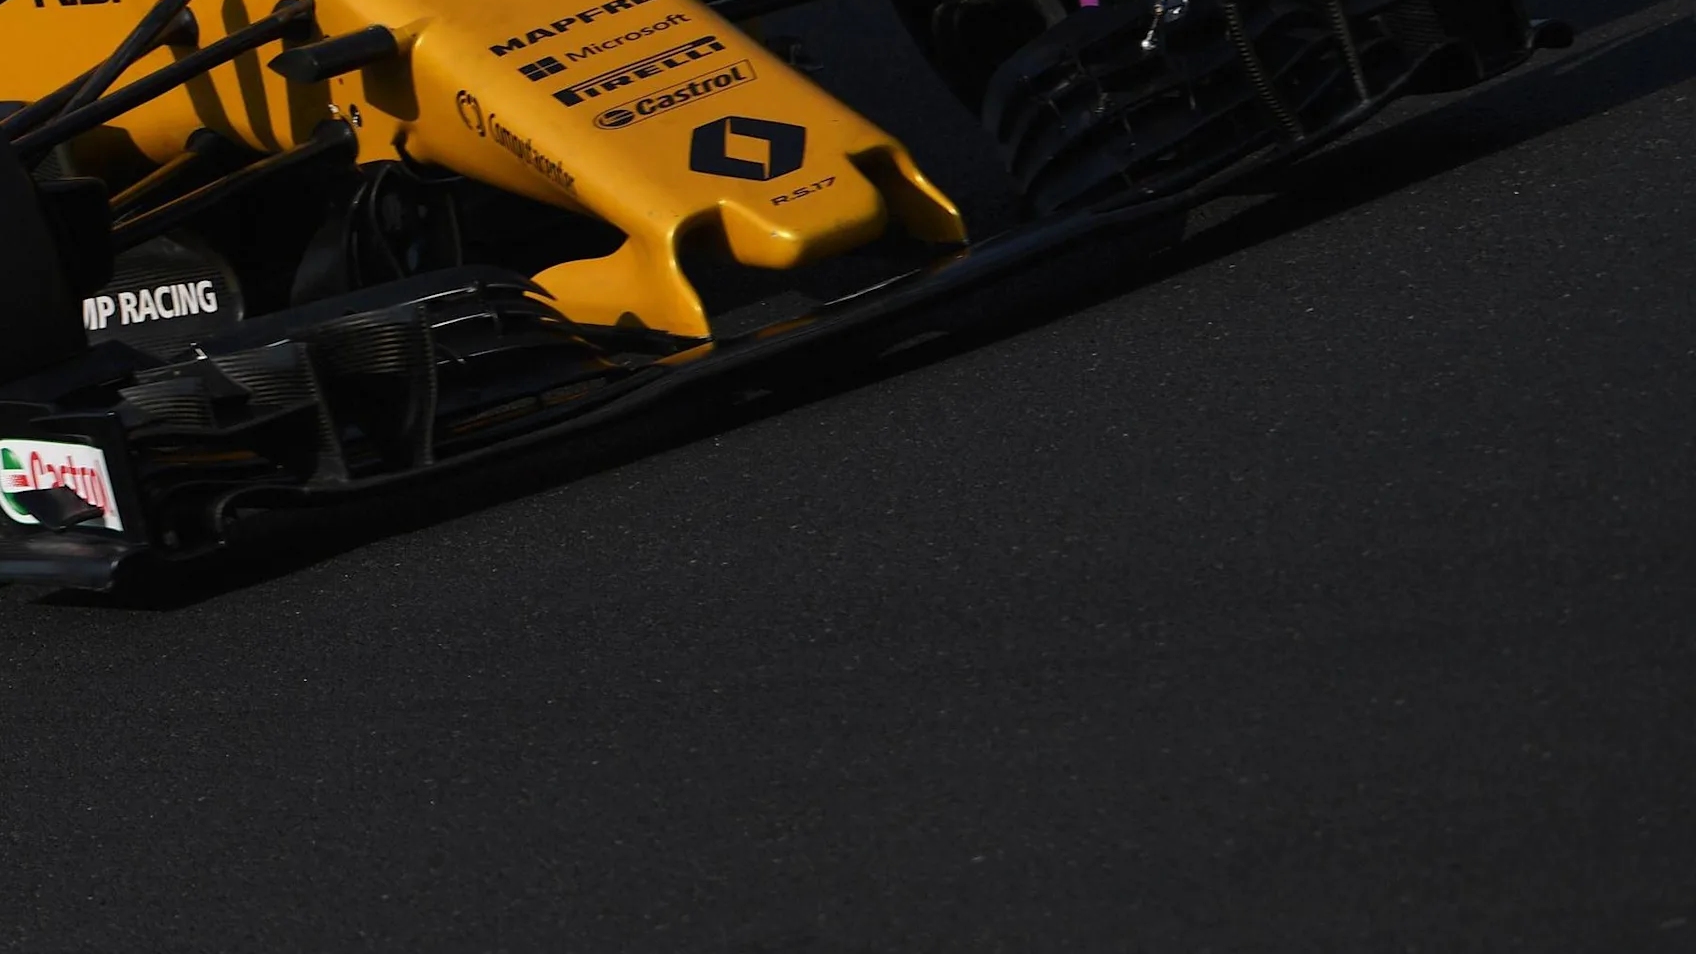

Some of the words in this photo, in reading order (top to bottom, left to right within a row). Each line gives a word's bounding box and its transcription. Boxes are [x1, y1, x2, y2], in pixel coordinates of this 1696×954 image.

[565, 13, 692, 62] Microsoft
[552, 35, 726, 107] PIRELLI
[636, 66, 747, 116] Castrol
[770, 176, 836, 207] R.S.17
[118, 280, 218, 326] RACING
